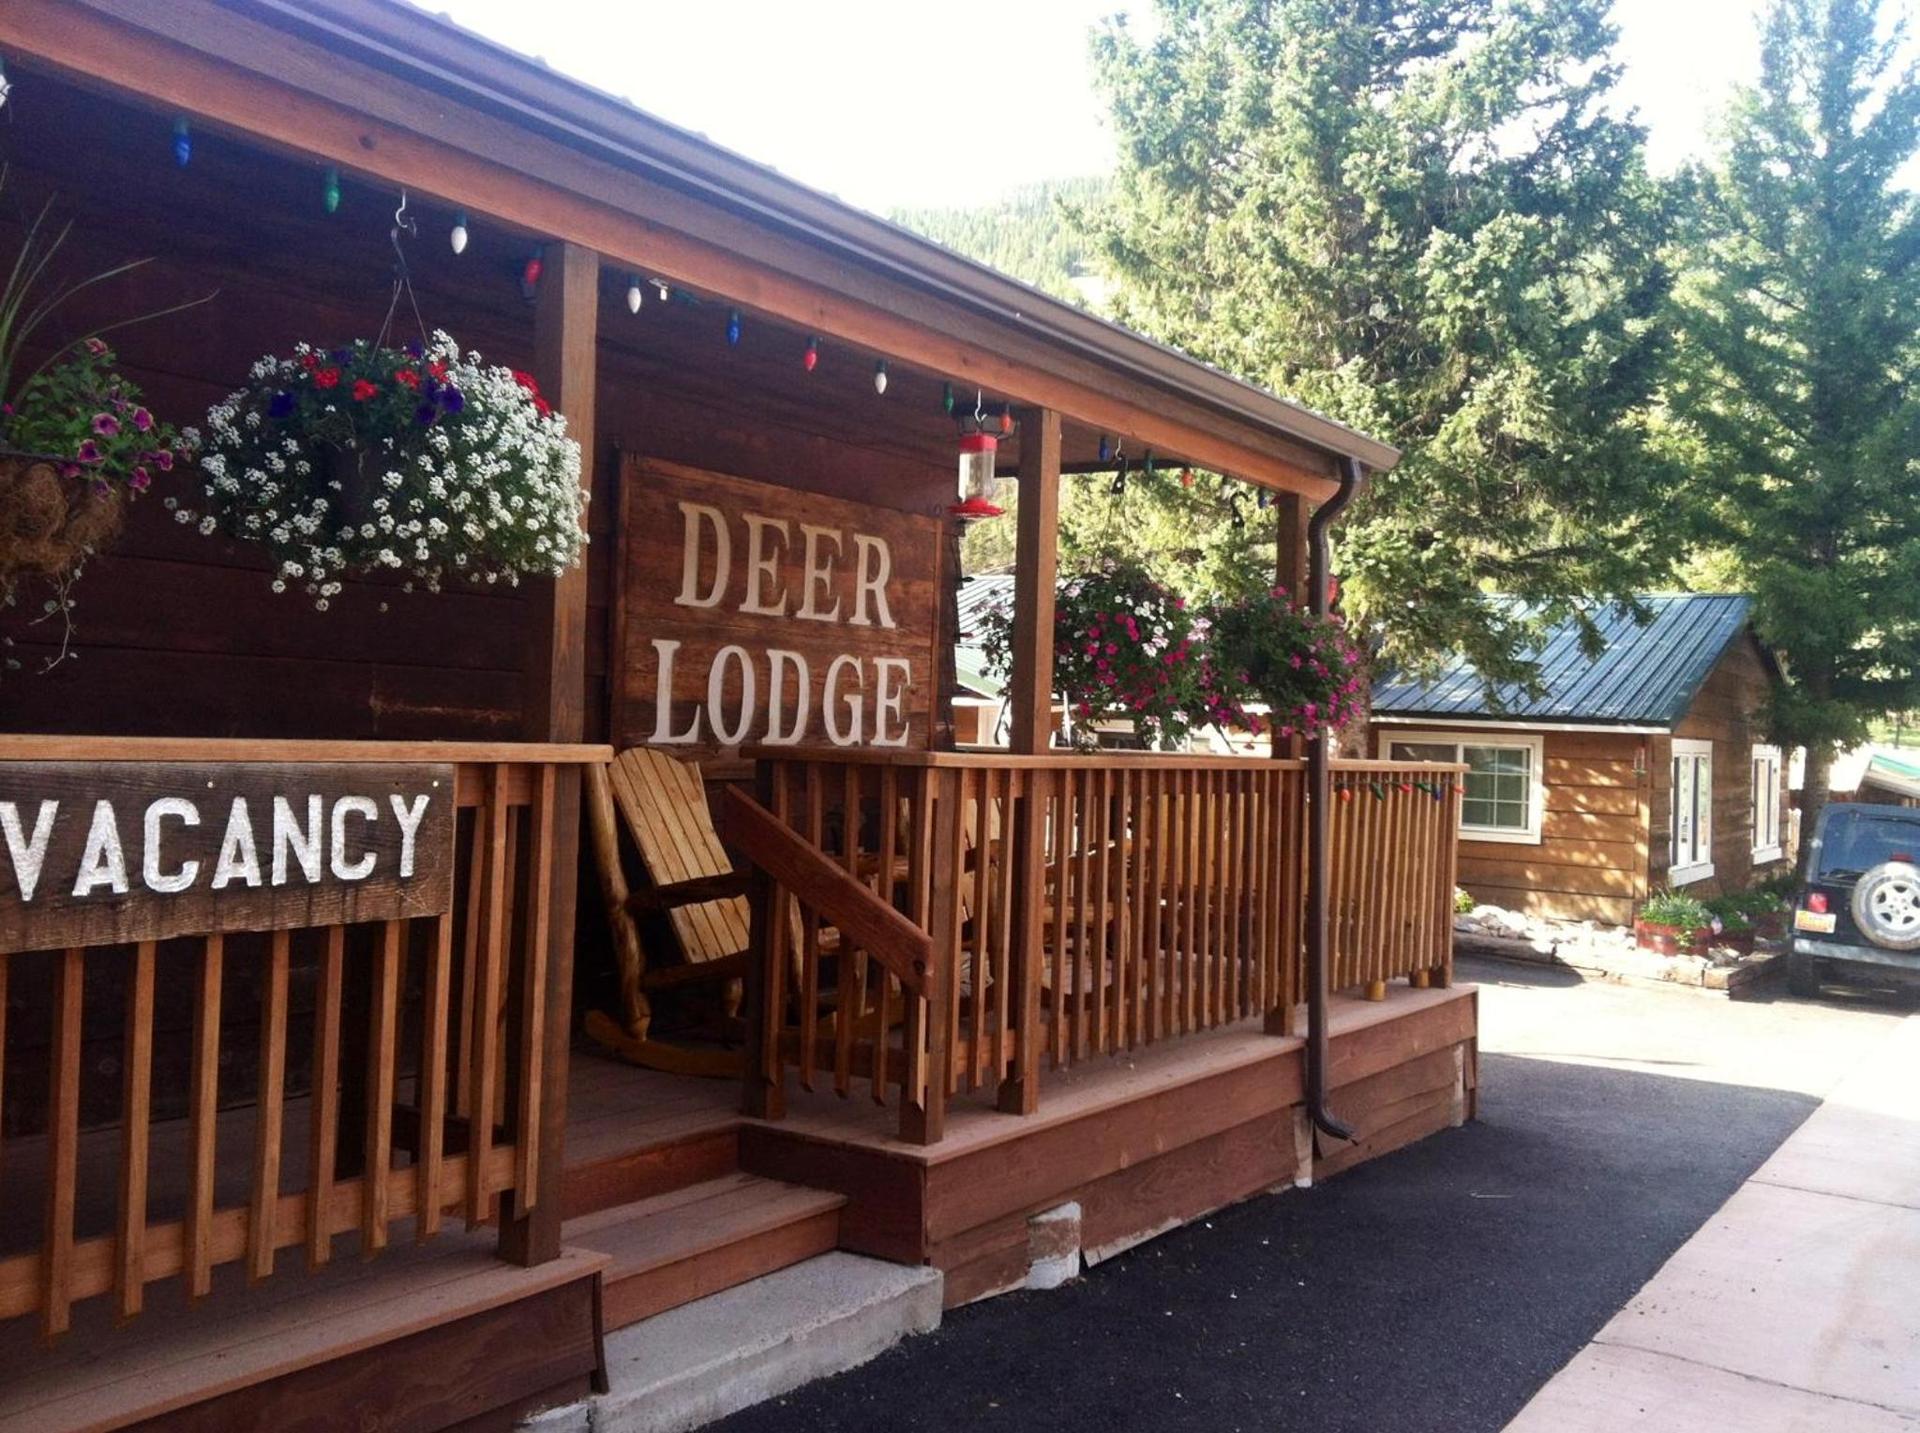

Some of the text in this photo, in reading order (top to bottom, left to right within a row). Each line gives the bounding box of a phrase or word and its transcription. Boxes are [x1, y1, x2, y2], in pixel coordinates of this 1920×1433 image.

[674, 502, 896, 628] DEER
[648, 639, 911, 747] LODGE
[0, 795, 430, 901] VACANCY
